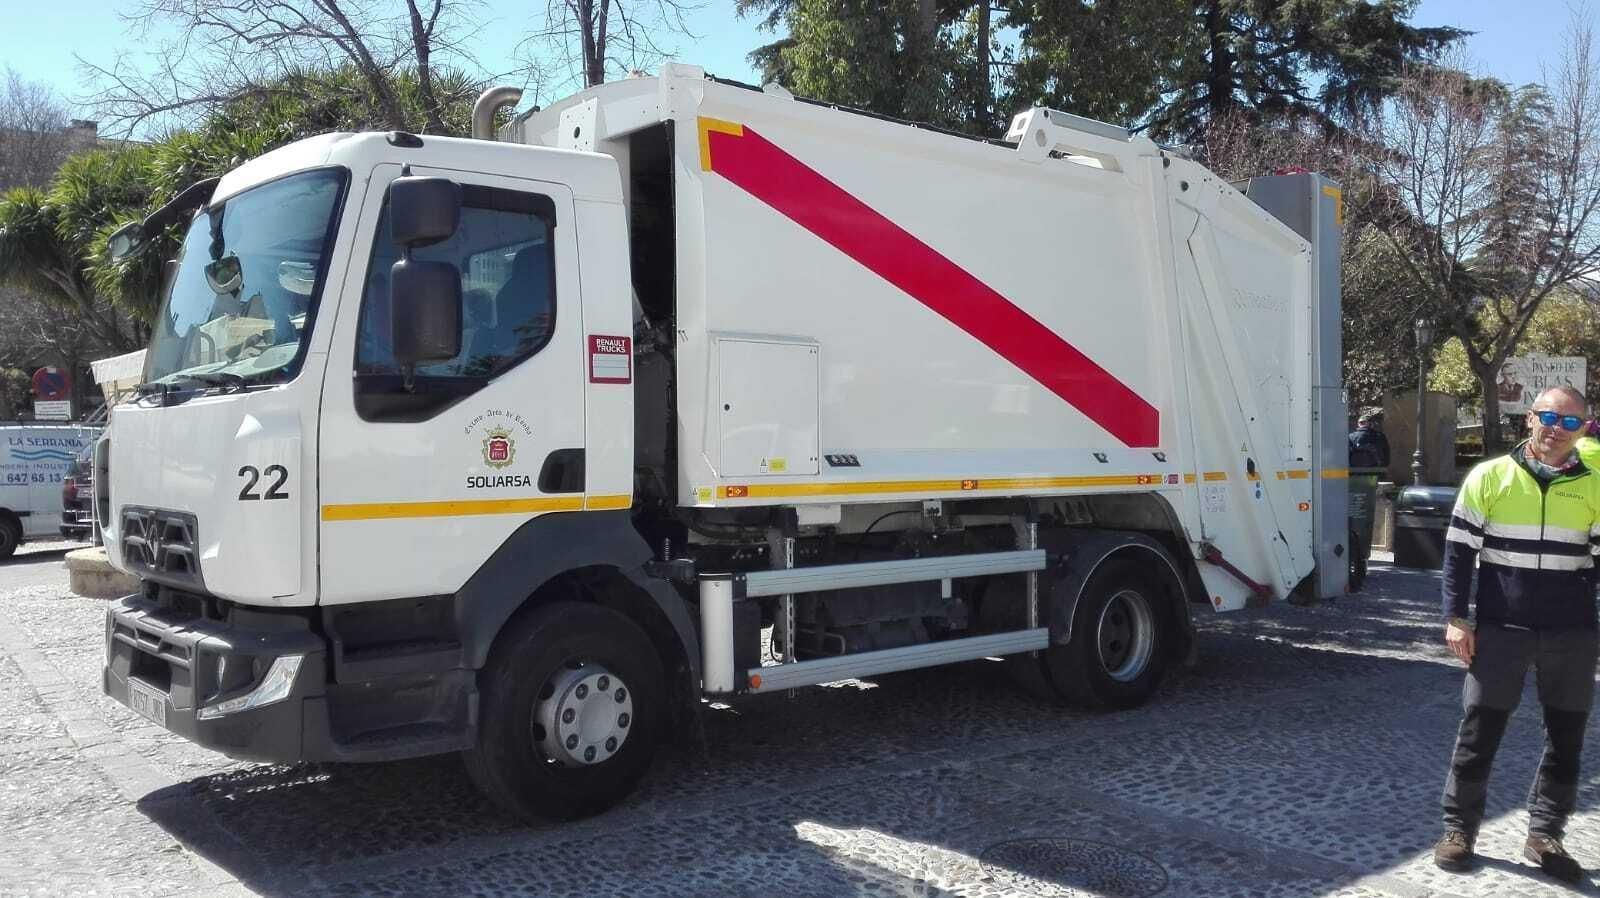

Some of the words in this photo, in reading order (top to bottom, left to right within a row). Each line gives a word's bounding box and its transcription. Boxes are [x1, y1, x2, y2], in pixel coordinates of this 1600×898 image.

[597, 338, 625, 347] RENAULT
[597, 345, 626, 353] TRUCKS
[9, 437, 24, 447] LA
[7, 473, 28, 482] 647
[466, 475, 531, 488] SOLIARSA
[238, 464, 289, 501] 22
